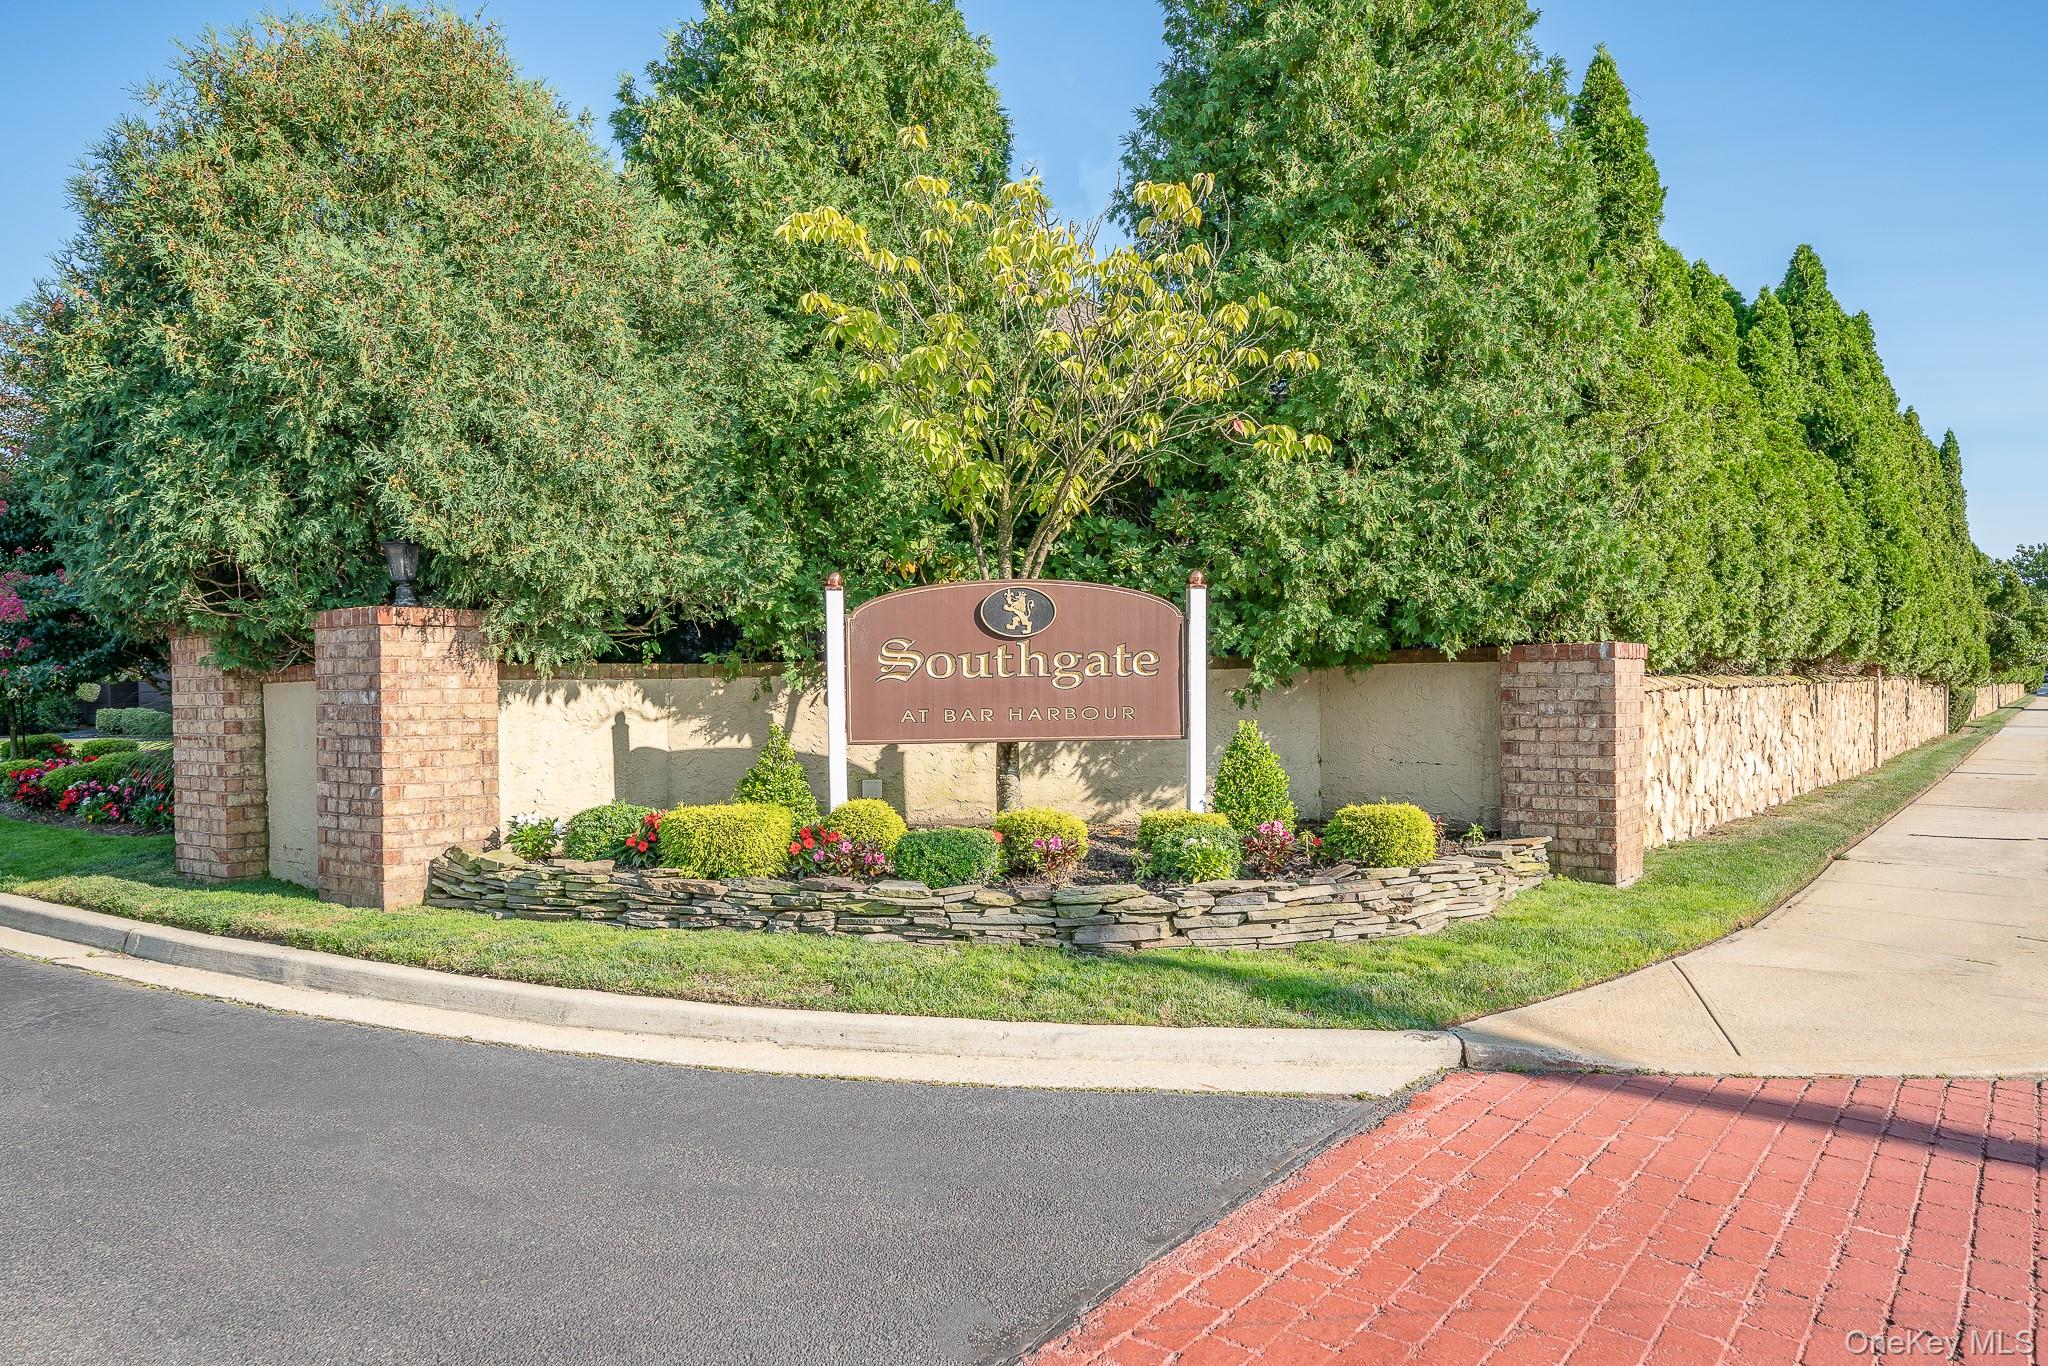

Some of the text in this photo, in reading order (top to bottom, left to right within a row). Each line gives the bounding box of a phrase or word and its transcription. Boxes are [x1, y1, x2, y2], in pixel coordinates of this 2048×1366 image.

[875, 637, 1160, 690] Southgate
[900, 705, 1136, 723] AT BAR HARBOUR
